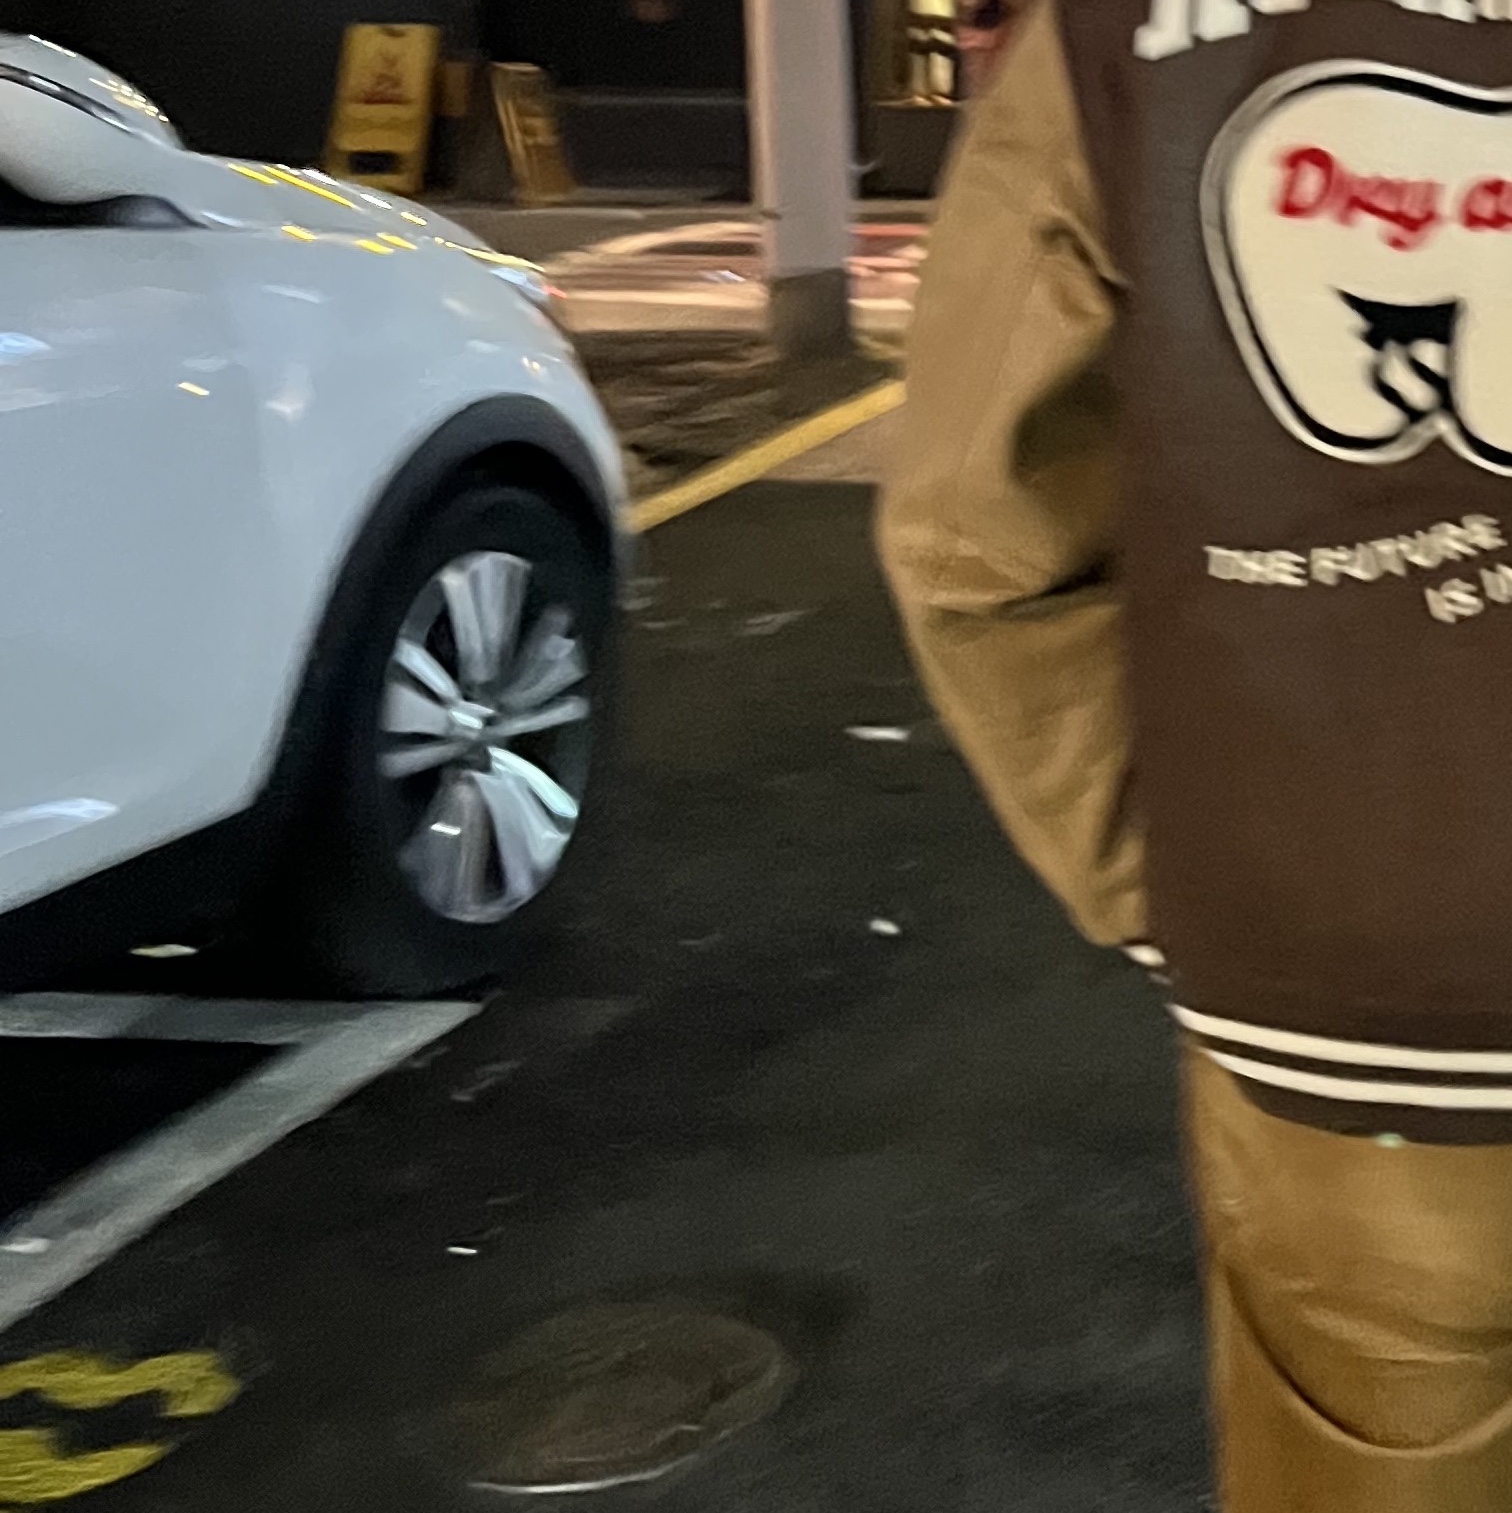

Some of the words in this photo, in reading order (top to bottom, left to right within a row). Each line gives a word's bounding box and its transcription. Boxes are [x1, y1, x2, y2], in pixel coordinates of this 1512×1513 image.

[1204, 545, 1308, 586] THE
[1310, 514, 1507, 585] FUTURE
[1424, 578, 1484, 622] IS
